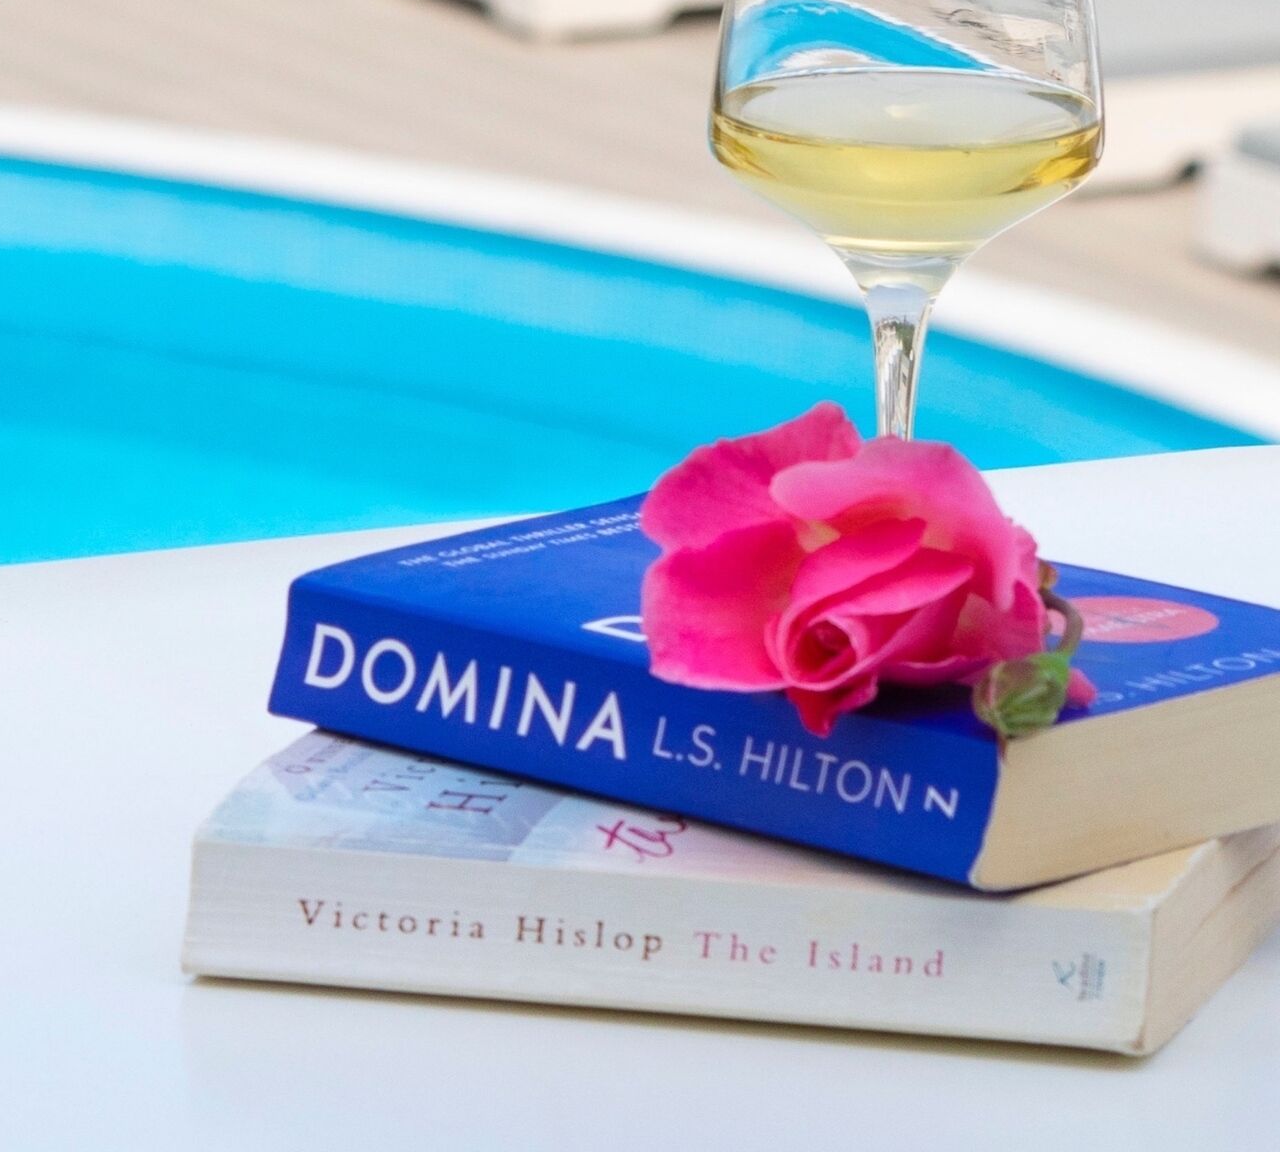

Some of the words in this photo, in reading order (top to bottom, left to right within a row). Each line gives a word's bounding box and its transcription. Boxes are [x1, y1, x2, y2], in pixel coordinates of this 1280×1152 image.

[397, 554, 438, 567] THE
[442, 555, 481, 568] THE
[304, 623, 626, 760] DOMINA
[652, 716, 721, 770] L.S.
[739, 735, 911, 814] HILTON
[298, 899, 485, 939] Victoria
[515, 915, 663, 960] Hislop
[693, 931, 777, 964] The
[808, 940, 945, 979] Island
